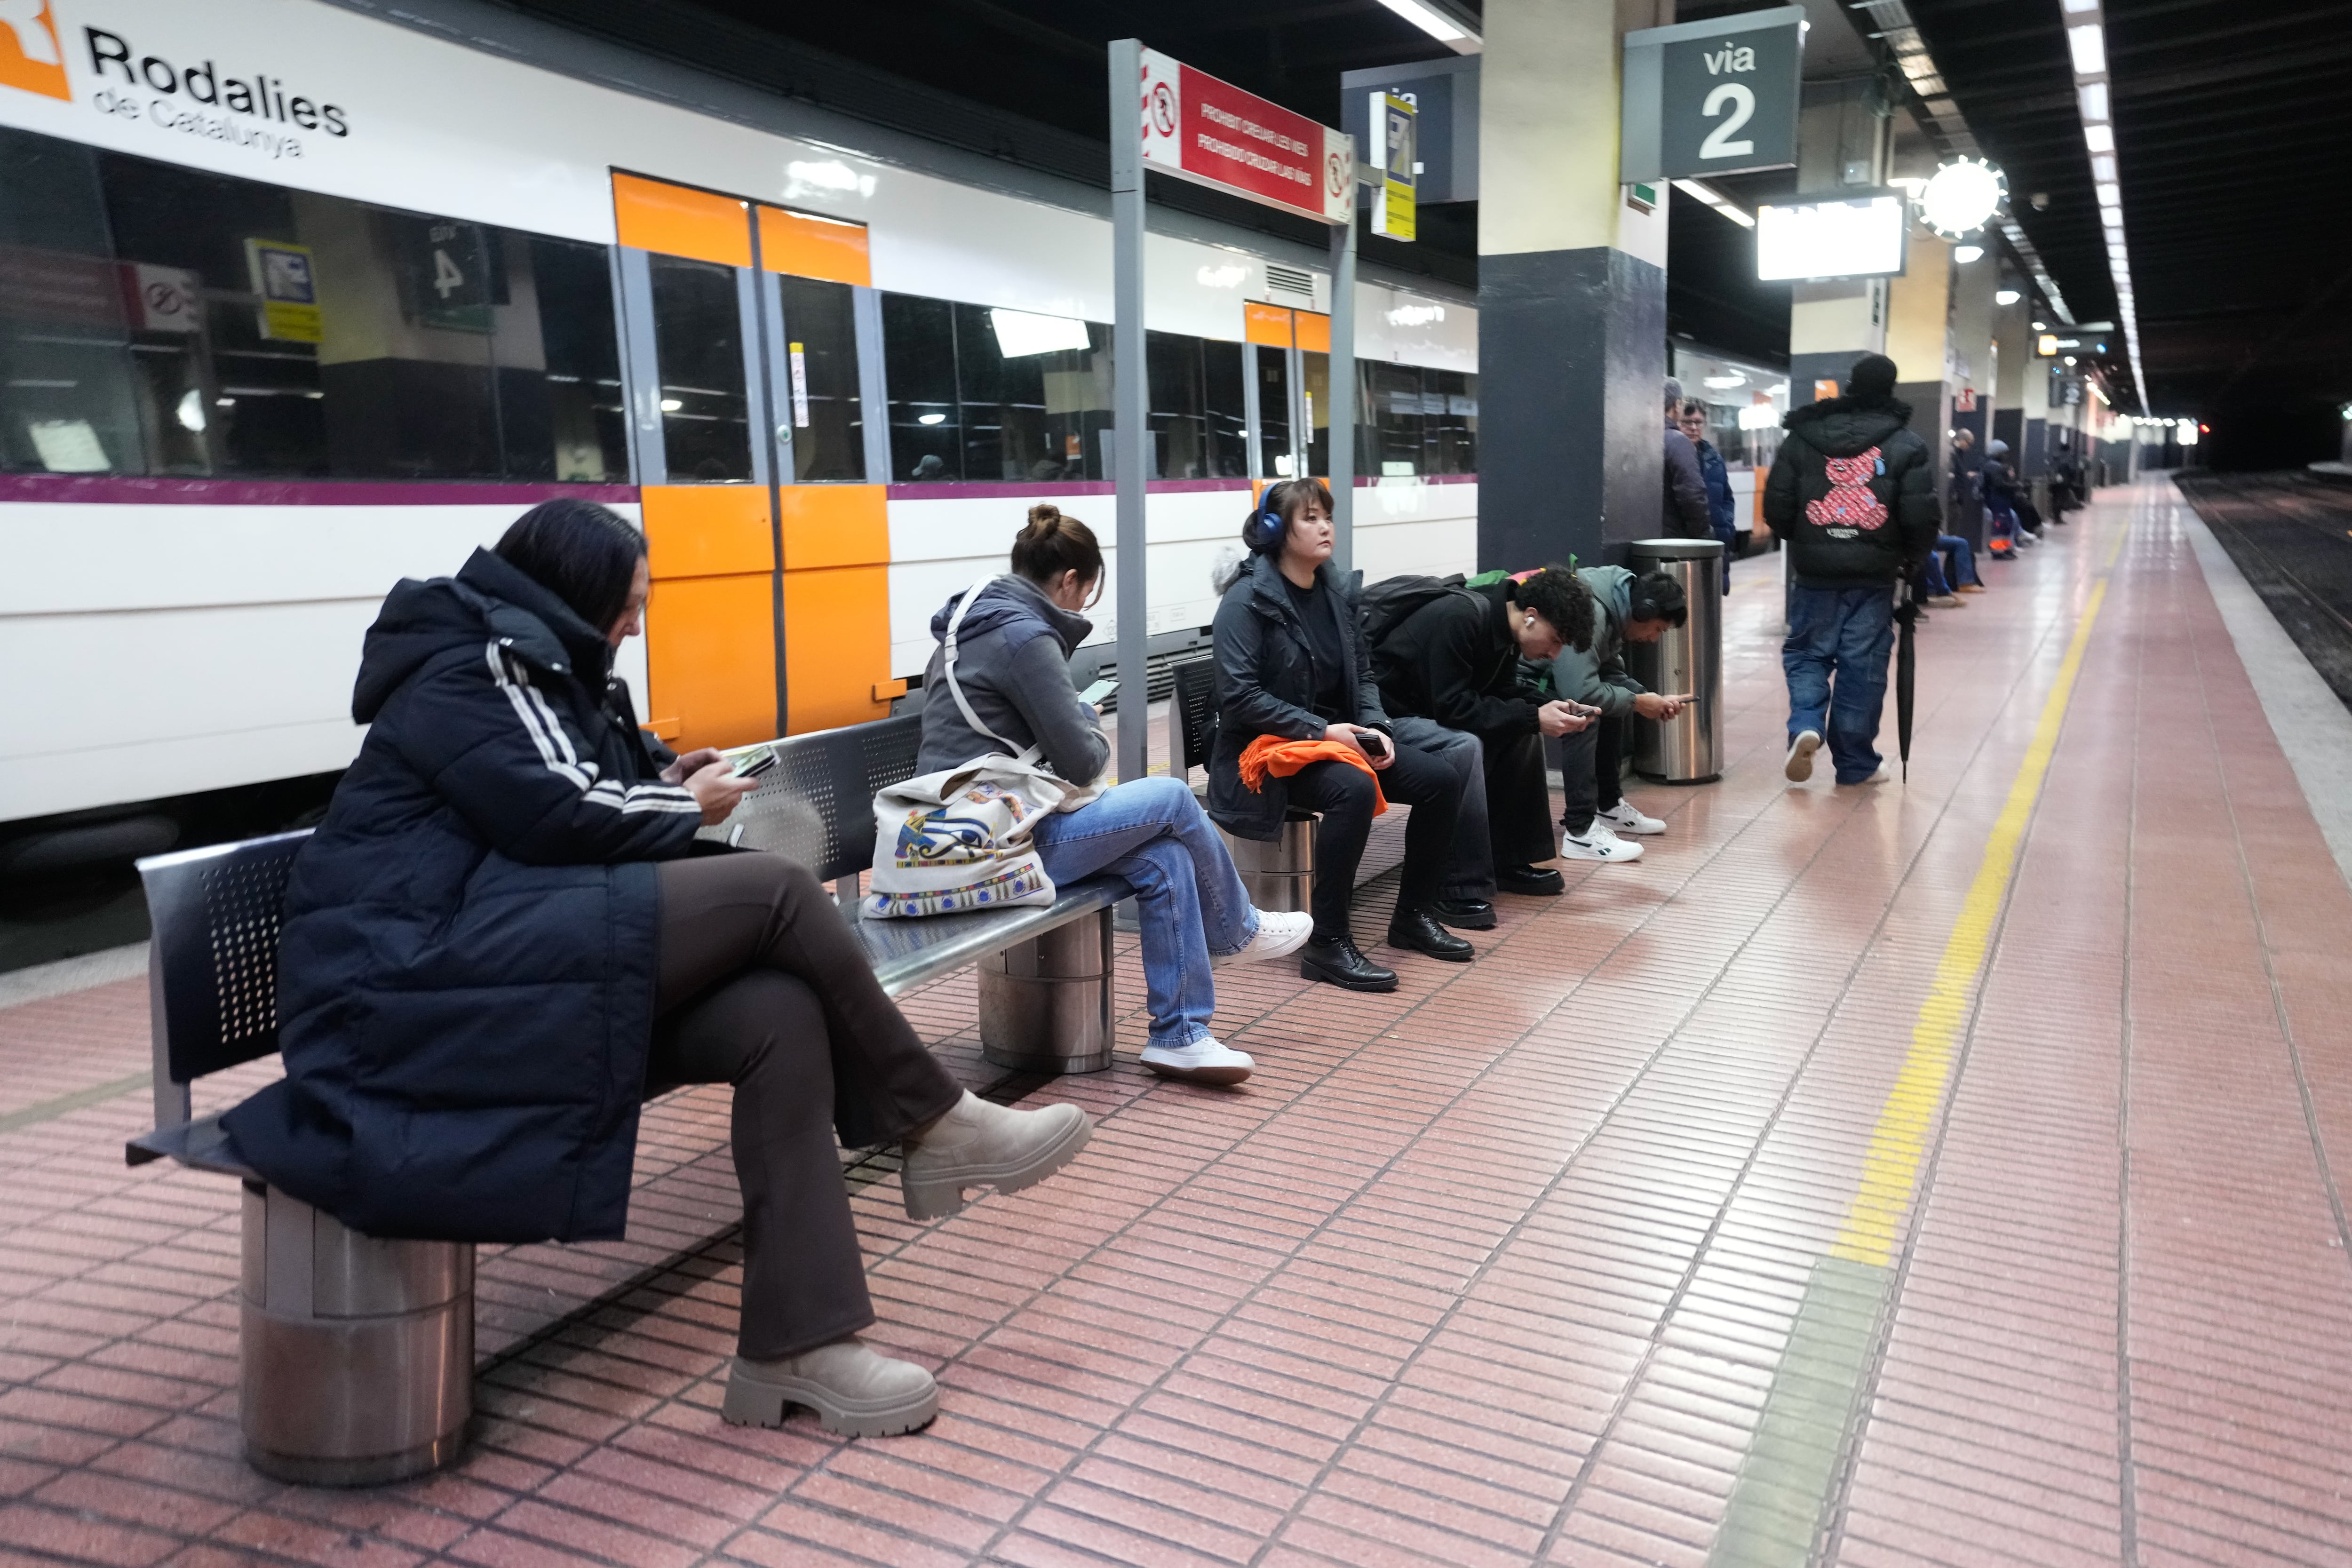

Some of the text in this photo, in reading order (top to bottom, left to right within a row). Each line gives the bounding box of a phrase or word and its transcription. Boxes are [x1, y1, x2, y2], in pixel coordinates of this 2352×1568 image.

[83, 25, 349, 138] Rodalies
[1703, 41, 1756, 76] via
[94, 88, 302, 159] de Catalunya
[1201, 103, 1242, 131] PROHIBIT
[1699, 82, 1756, 160] 2
[1198, 133, 1246, 162] PROHIBIDO
